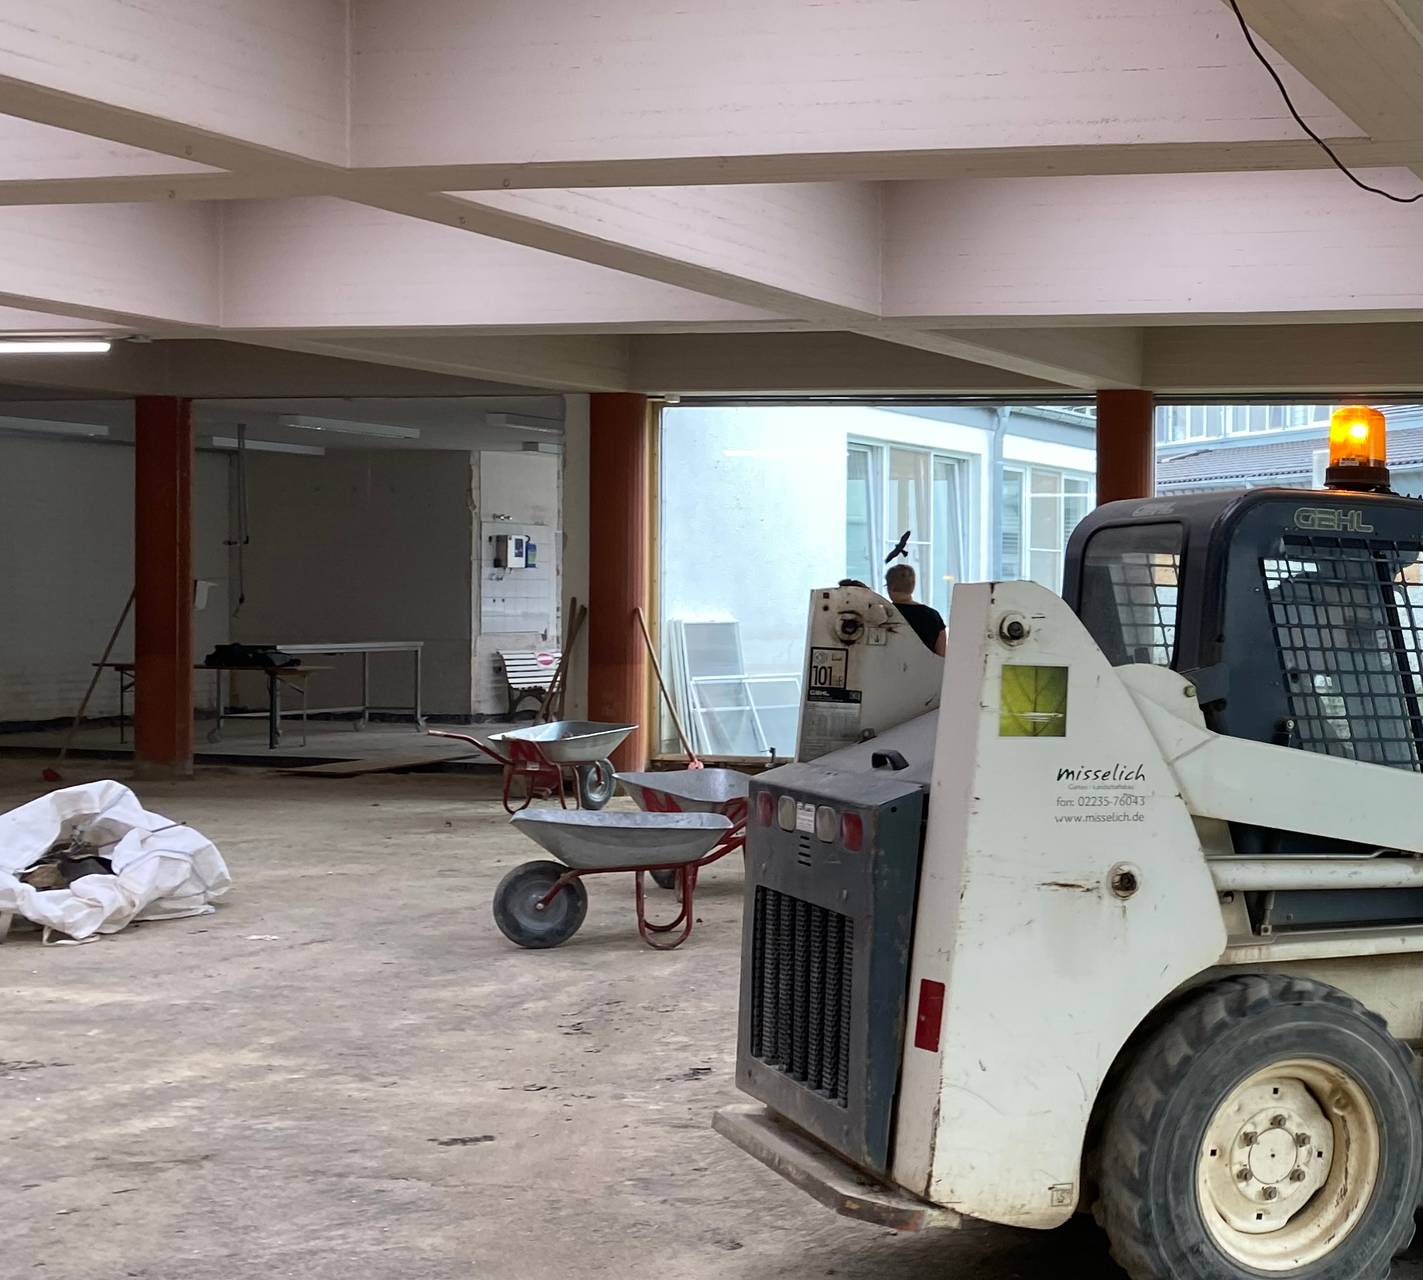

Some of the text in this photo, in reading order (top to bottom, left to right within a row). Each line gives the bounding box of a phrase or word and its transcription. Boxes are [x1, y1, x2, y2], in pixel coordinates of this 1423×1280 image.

[1294, 507, 1374, 533] GEHL
[812, 665, 833, 686] 101
[1056, 763, 1145, 781] misselich
[1077, 796, 1146, 807] 02235-76043
[1054, 811, 1145, 823] www.misselich.de
